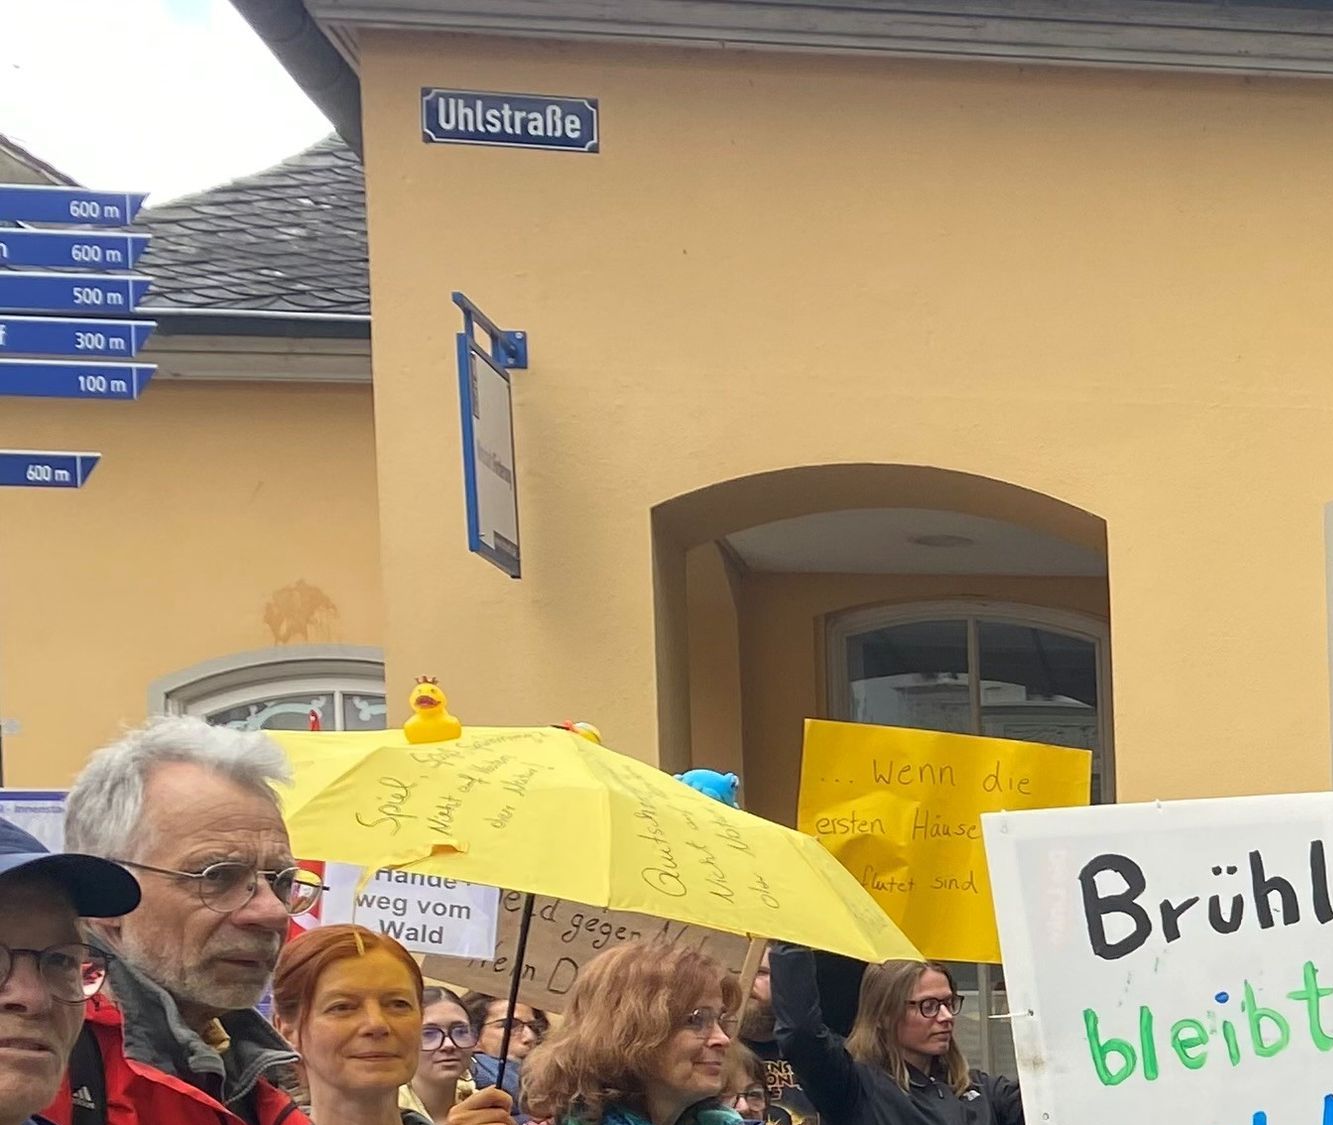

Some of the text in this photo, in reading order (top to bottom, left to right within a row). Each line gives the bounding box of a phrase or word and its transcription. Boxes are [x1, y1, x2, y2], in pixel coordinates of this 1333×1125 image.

[438, 98, 582, 139] Uhlstraße
[69, 201, 120, 219] 600 m
[71, 245, 122, 263] 600 m
[72, 287, 123, 305] 500 m
[74, 332, 125, 351] 300 m
[78, 375, 127, 393] 100 m
[26, 466, 70, 482] 600 m
[872, 759, 956, 787] Wenn
[982, 761, 1032, 795] die
[815, 806, 980, 841] ersten Häuse
[861, 865, 979, 894] flutet sind
[357, 894, 471, 920] weg vom
[379, 919, 444, 945] Wald
